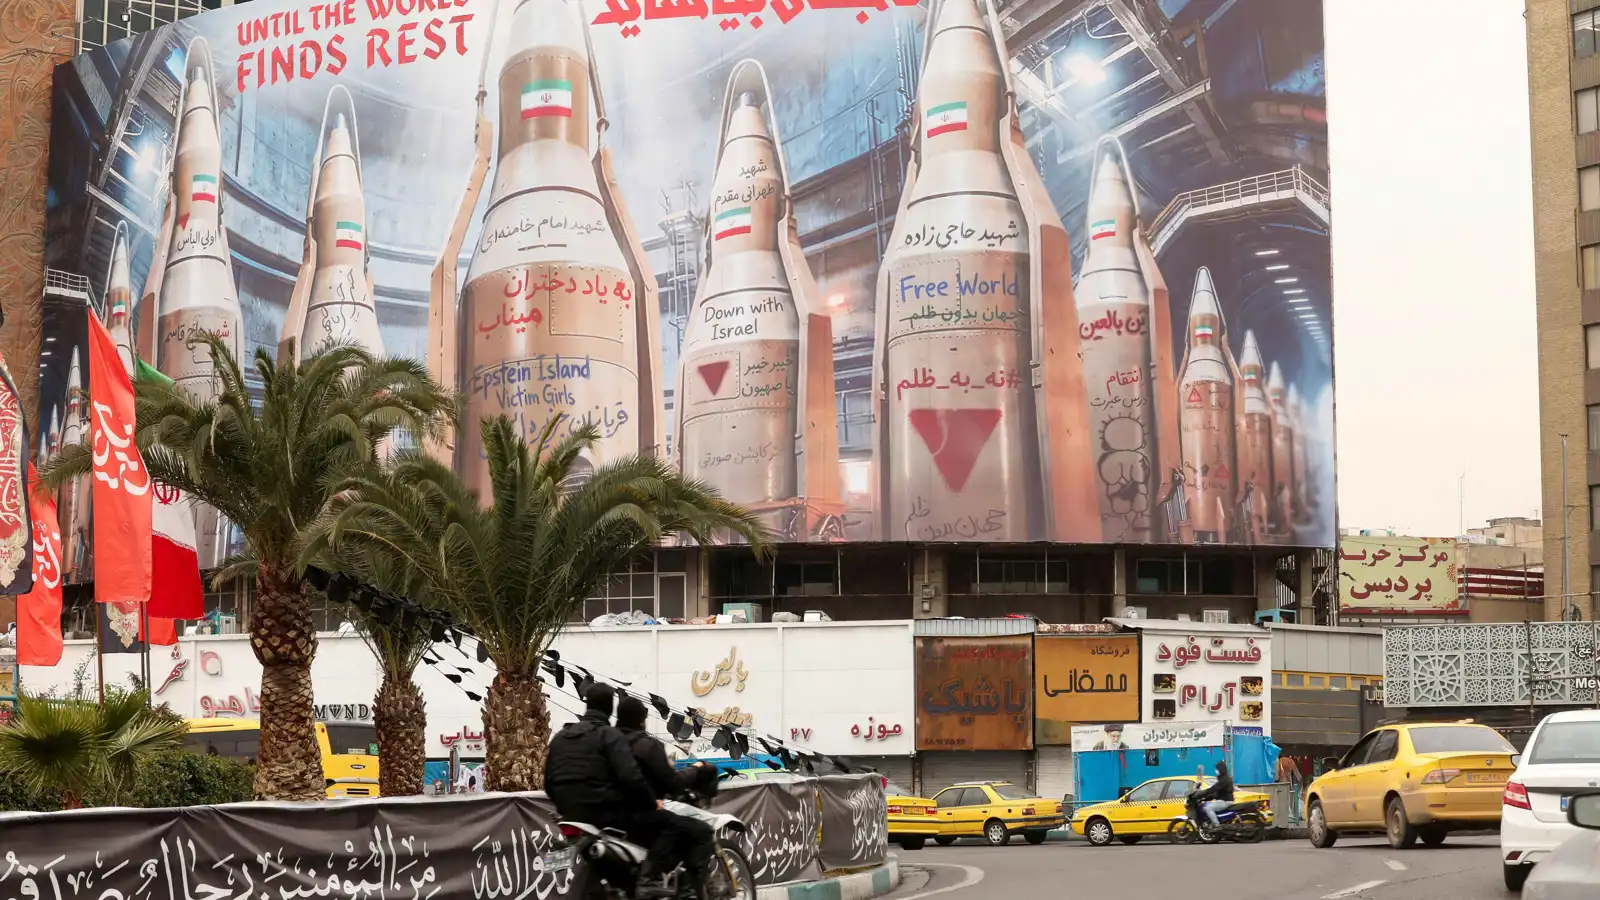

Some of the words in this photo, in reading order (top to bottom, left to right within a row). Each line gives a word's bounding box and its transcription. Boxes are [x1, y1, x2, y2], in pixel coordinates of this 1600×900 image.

[237, 9, 305, 46] UNTIL
[308, 0, 357, 31] THE
[366, 0, 470, 21] WOR
[237, 34, 348, 94] FINDS
[366, 13, 475, 69] REST
[738, 158, 768, 179] شهید
[714, 189, 740, 213] مقدم
[537, 215, 568, 238] امام
[571, 219, 606, 236] شهید
[977, 220, 1020, 249] شهید
[503, 269, 579, 301] دختران
[582, 274, 608, 305] یاد
[612, 280, 632, 309] به
[899, 274, 949, 304] Free
[957, 271, 1020, 300] World
[476, 303, 543, 340] میناب
[704, 304, 745, 323] Down
[750, 296, 784, 314] with
[711, 318, 758, 341] Israel
[472, 359, 531, 400] Epstein
[536, 354, 592, 382] Island
[743, 357, 770, 377] خیبر
[496, 387, 540, 410] Victim
[542, 383, 576, 409] Girls
[741, 382, 783, 398] صهیون
[1089, 395, 1122, 412] عبرت
[698, 451, 732, 470] صورتی
[733, 441, 773, 466] کاپشن
[1339, 543, 1392, 567] خرید
[1394, 544, 1449, 568] مرکز
[1349, 575, 1433, 602] پردیس
[1091, 645, 1130, 658] فروشگاه
[1156, 635, 1201, 668] فود
[1205, 636, 1262, 663] فست
[691, 645, 749, 698] بالین
[1180, 682, 1238, 712] آرام
[439, 725, 486, 750] یبایی
[790, 727, 812, 742] ۲۷
[850, 716, 903, 741] موزه
[1142, 728, 1179, 744] برادران
[1178, 727, 1207, 742] موکب
